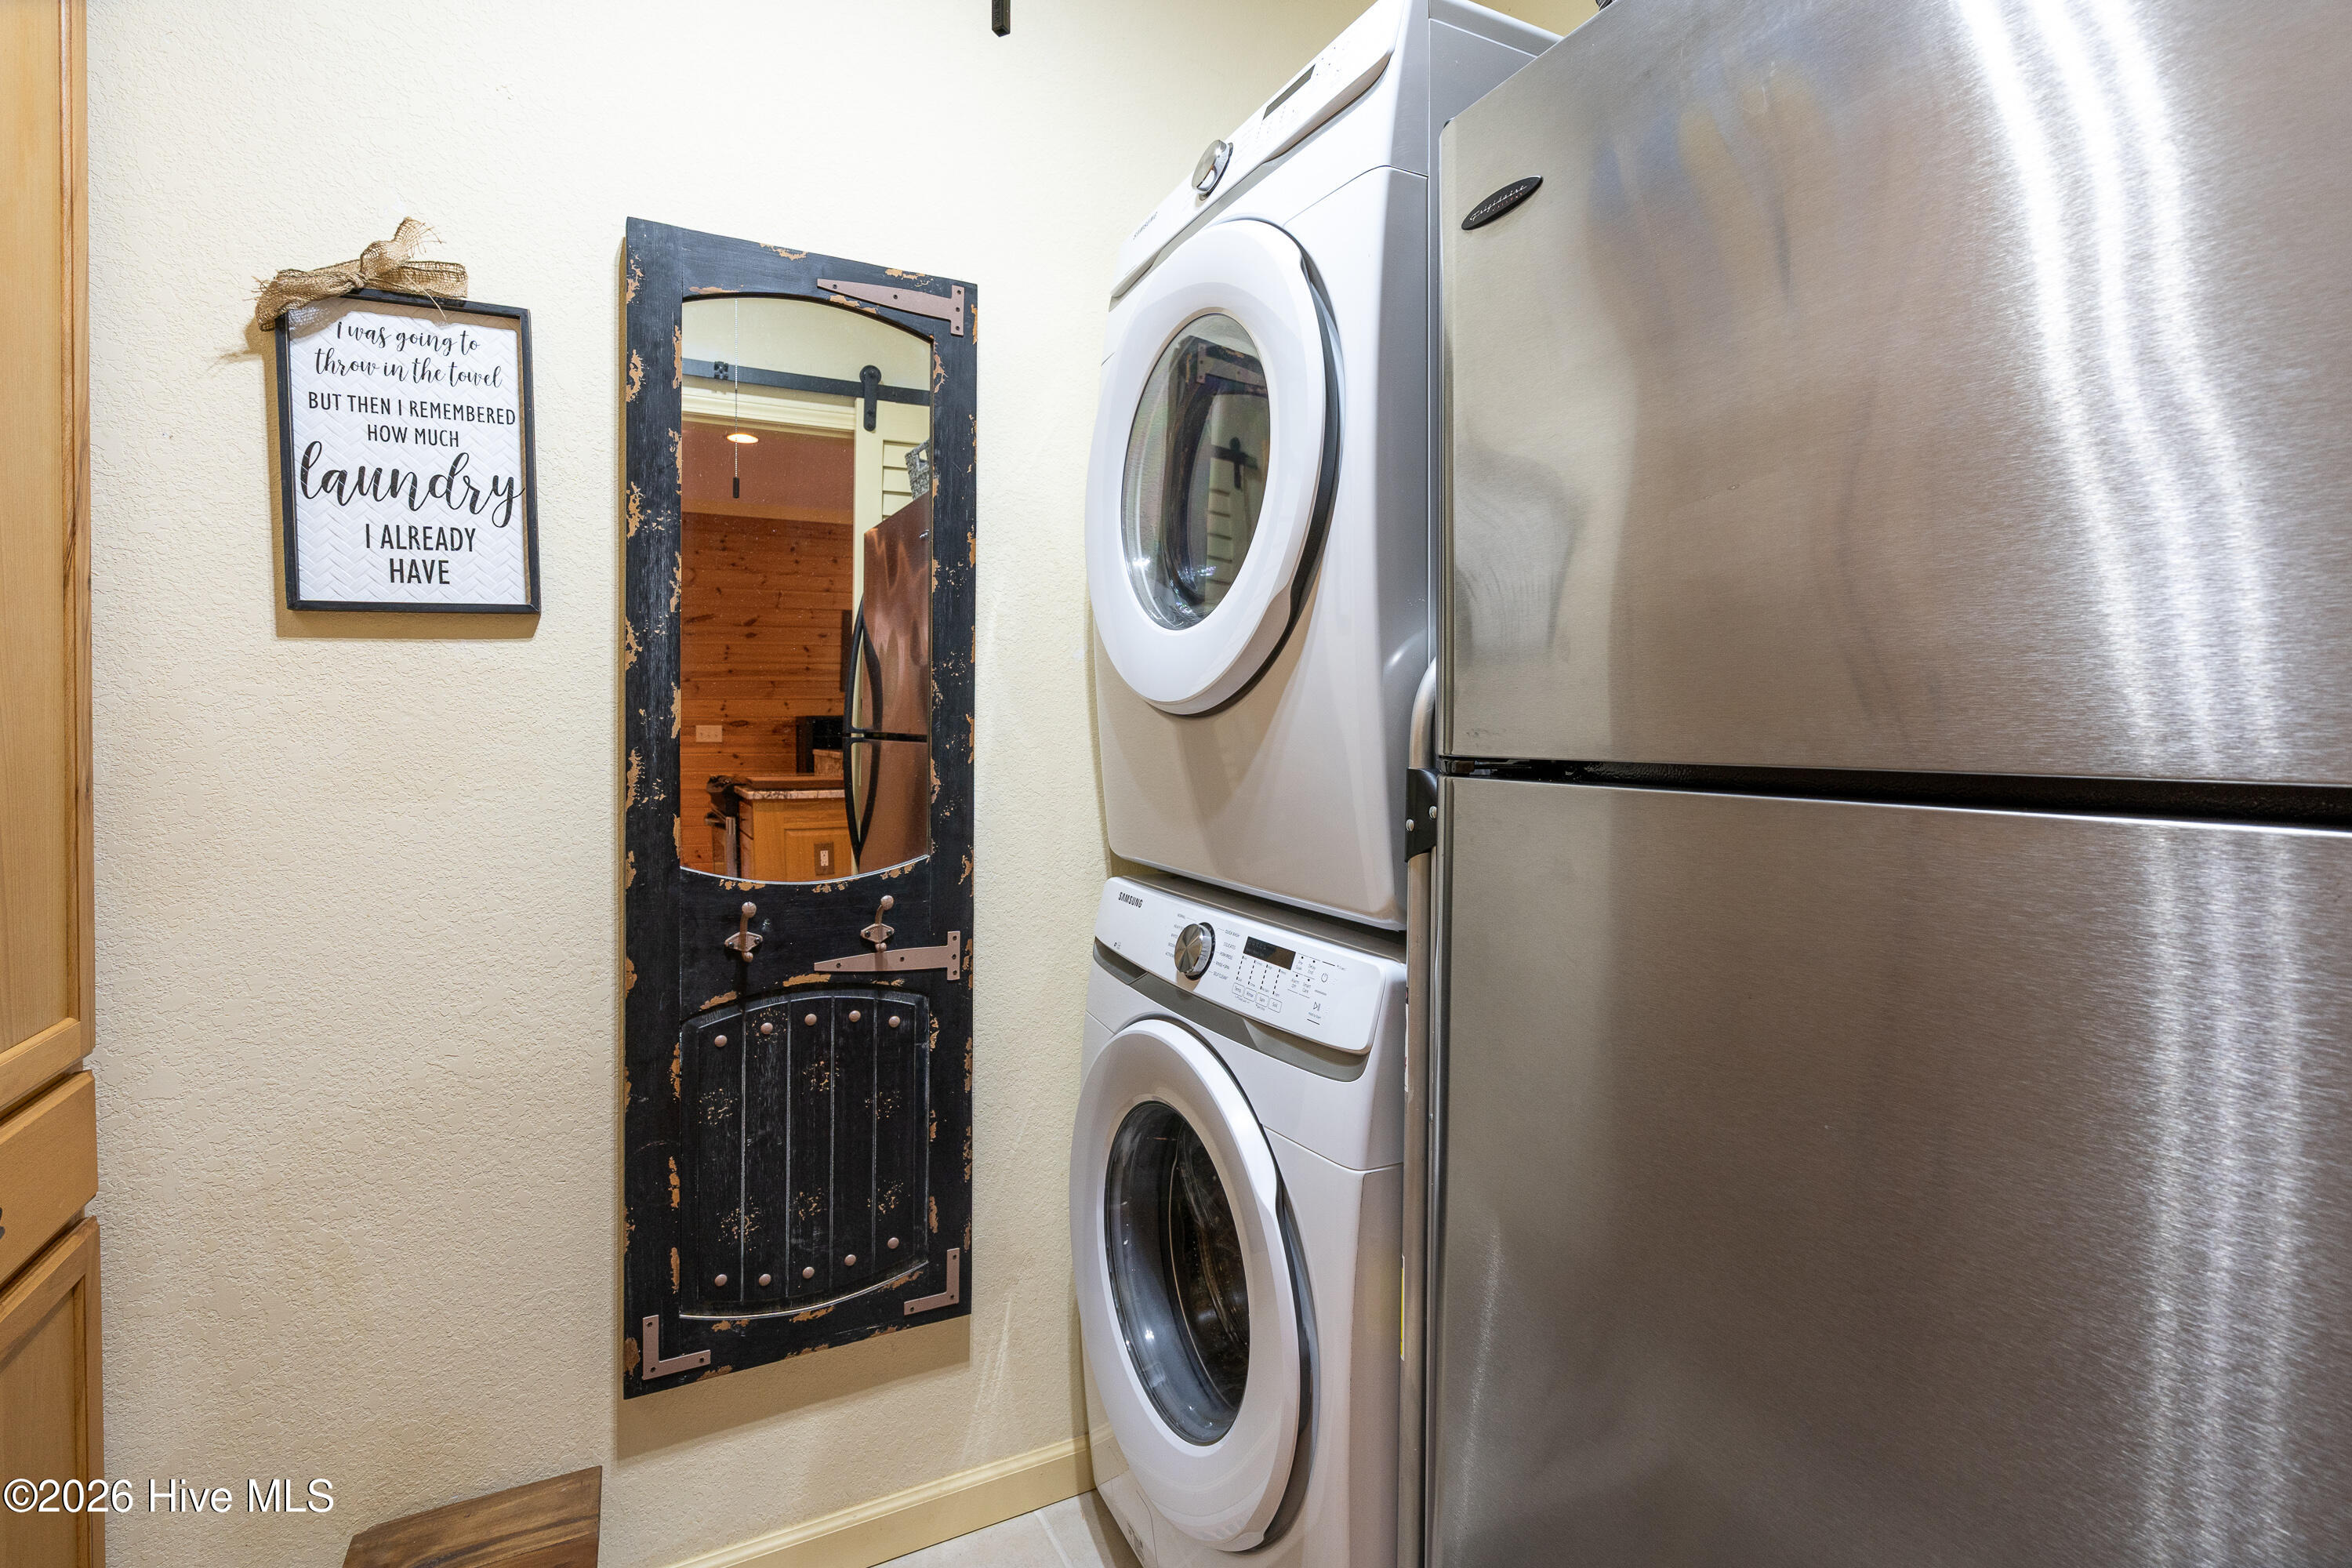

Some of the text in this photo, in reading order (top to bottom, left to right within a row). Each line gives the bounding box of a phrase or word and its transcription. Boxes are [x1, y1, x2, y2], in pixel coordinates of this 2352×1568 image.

[336, 321, 481, 356] I was going to
[314, 347, 503, 388] throw in the towel
[308, 391, 516, 426] BUT THEN I REMEMBERED
[367, 424, 459, 448] HOW MUCH
[299, 441, 526, 528] laundry
[365, 524, 476, 552] I ALREADY
[390, 557, 450, 585] HAVE
[1118, 891, 1143, 909] SAMSUNG
